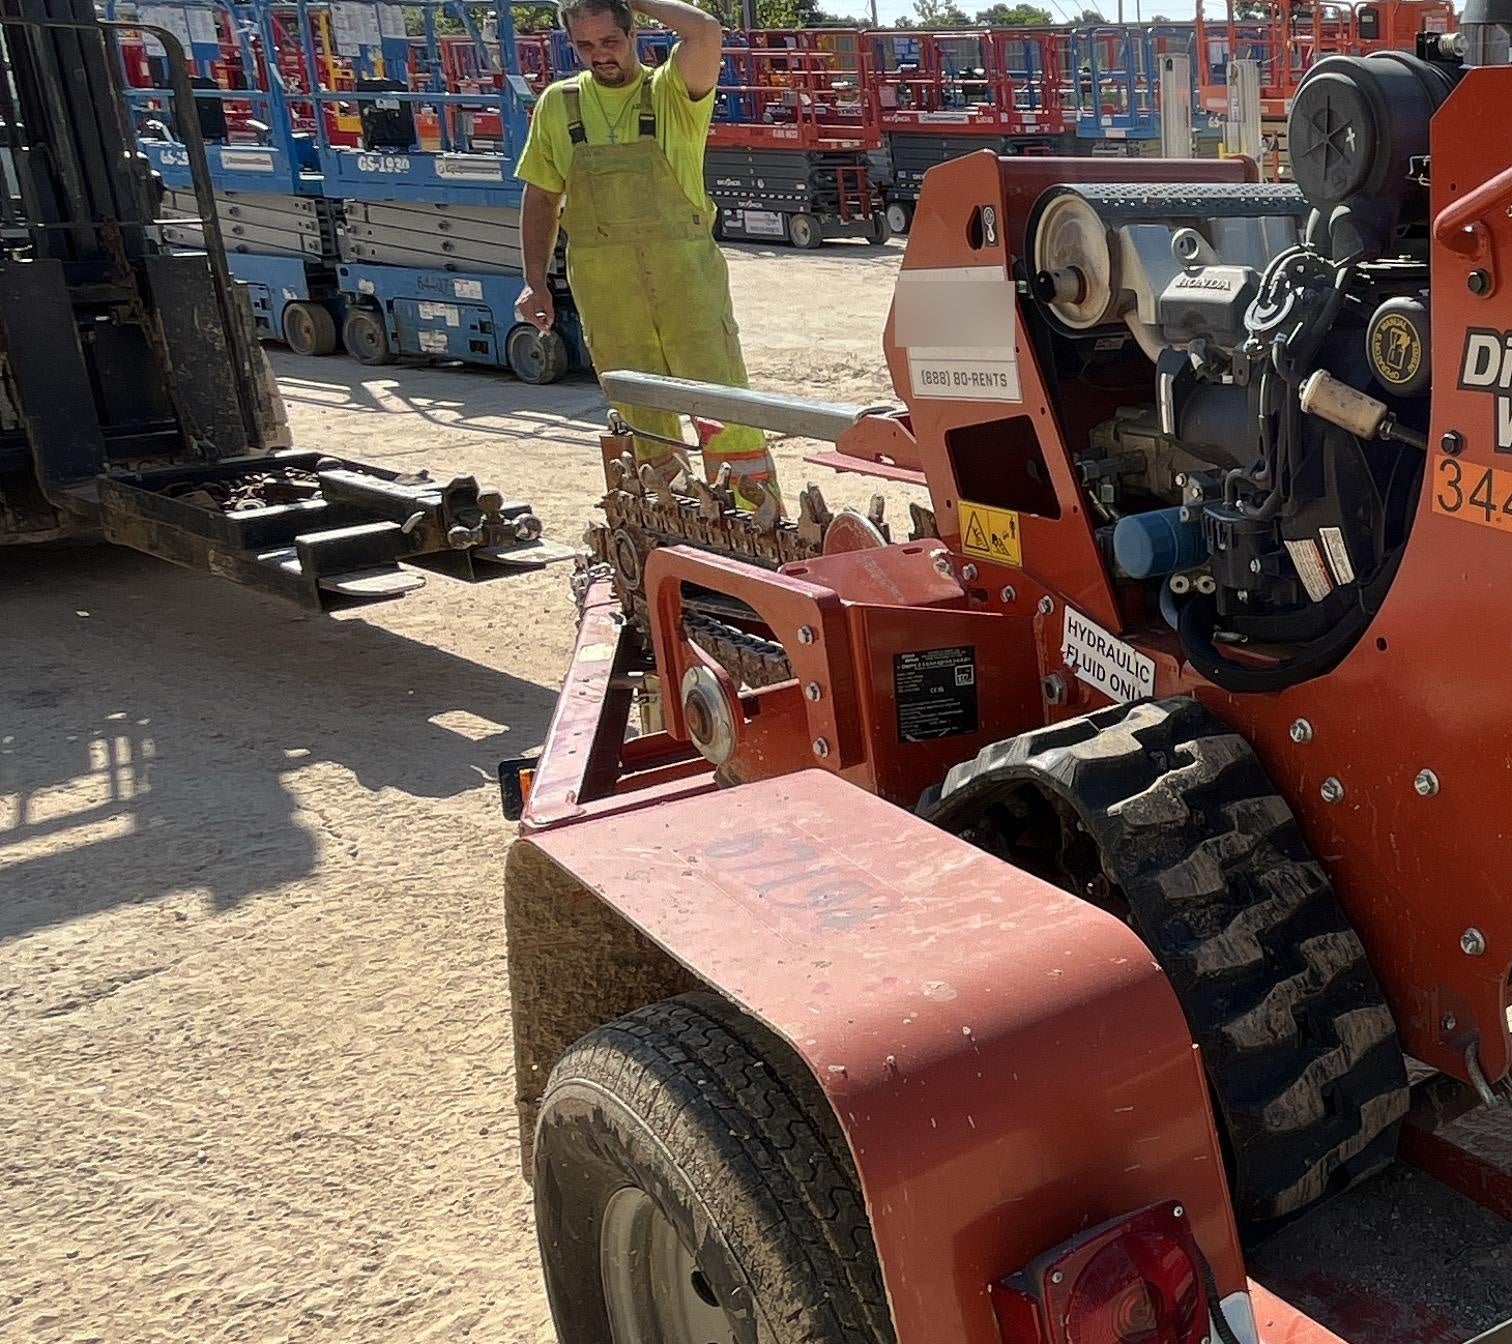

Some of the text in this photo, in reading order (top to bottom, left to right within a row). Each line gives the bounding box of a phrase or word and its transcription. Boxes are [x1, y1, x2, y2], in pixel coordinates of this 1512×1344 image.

[357, 156, 411, 174] GS-1930
[1176, 276, 1232, 292] HONDA
[921, 369, 1008, 387] (888) 80-RENTS
[1067, 616, 1150, 684] HYDRAULIC
[1066, 643, 1106, 682] FLUID
